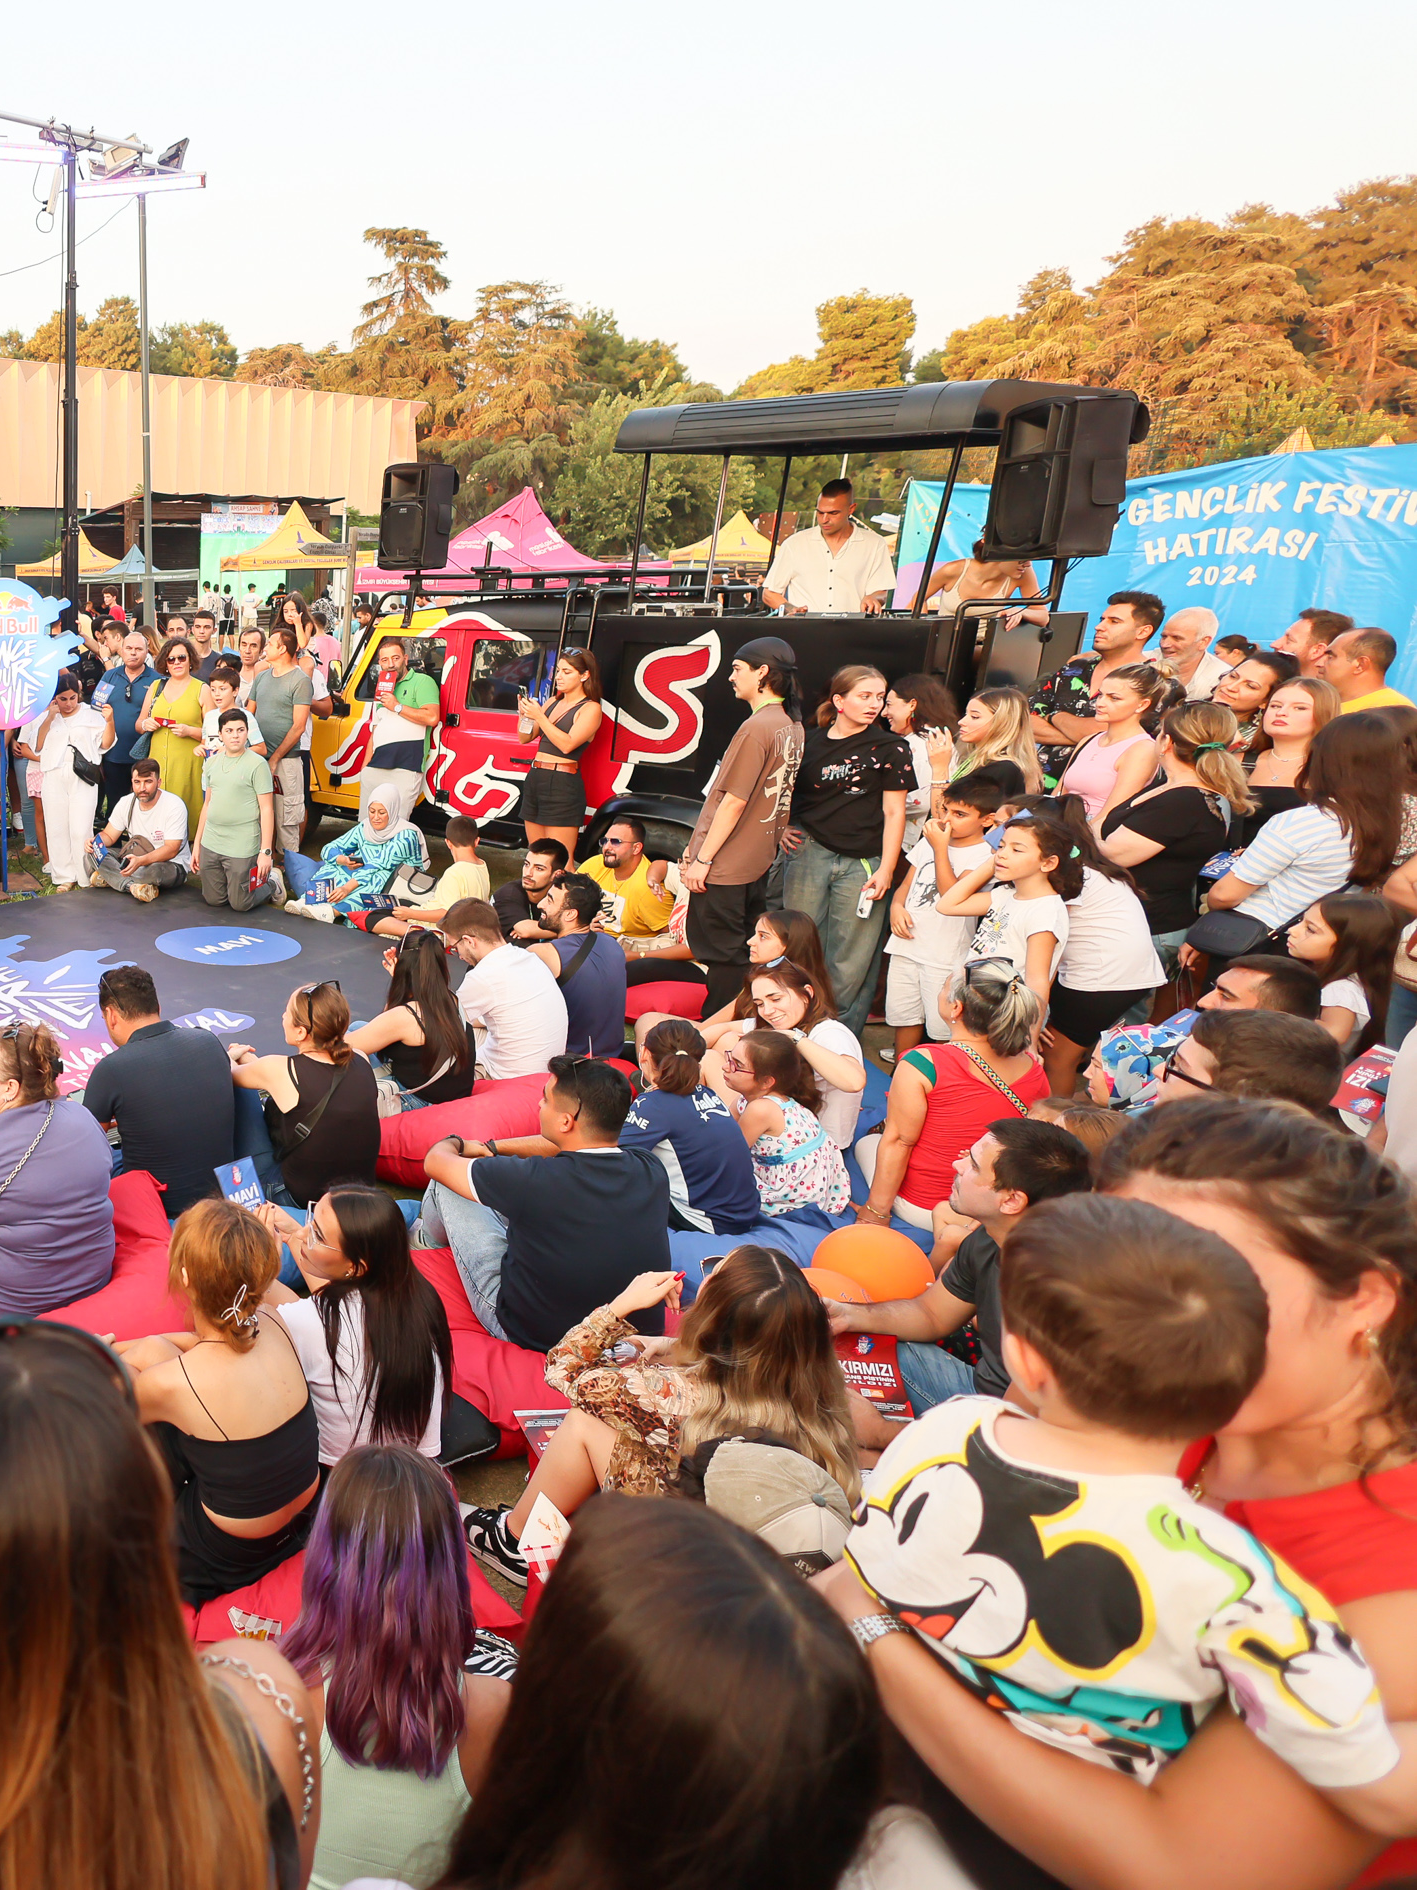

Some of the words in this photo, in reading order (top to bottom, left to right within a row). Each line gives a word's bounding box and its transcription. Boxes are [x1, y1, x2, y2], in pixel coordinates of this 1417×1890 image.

[1127, 481, 1287, 526] GENÇLİK
[1143, 526, 1319, 565] HATIRASI
[1186, 564, 1257, 587] 2024
[6, 616, 38, 634] Bull
[194, 934, 264, 956] MAVİ
[228, 1182, 260, 1204] MAVİ
[839, 1360, 894, 1377] KIRMIZI
